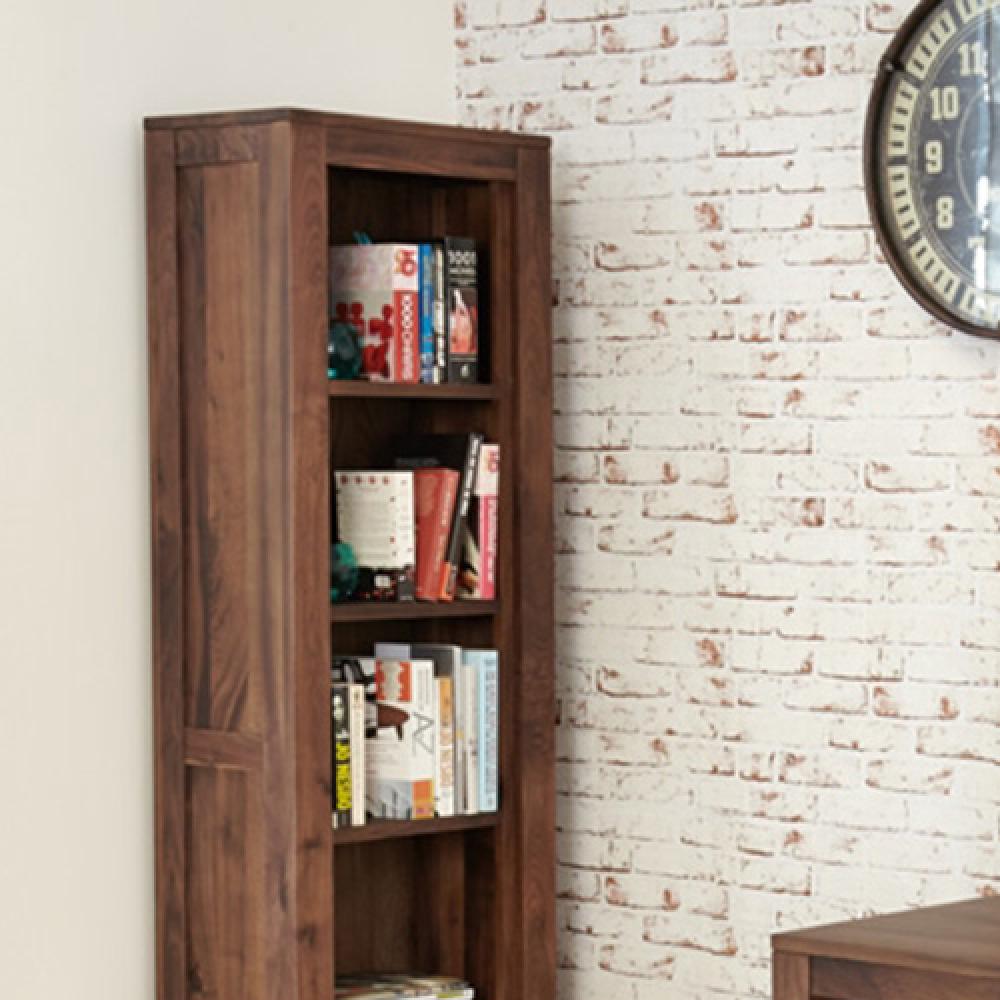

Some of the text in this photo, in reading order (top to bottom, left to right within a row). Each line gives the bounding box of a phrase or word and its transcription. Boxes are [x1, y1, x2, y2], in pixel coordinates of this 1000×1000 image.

[958, 40, 986, 76] 11
[928, 86, 959, 120] 10
[925, 140, 943, 174] 9
[935, 196, 954, 229] 8
